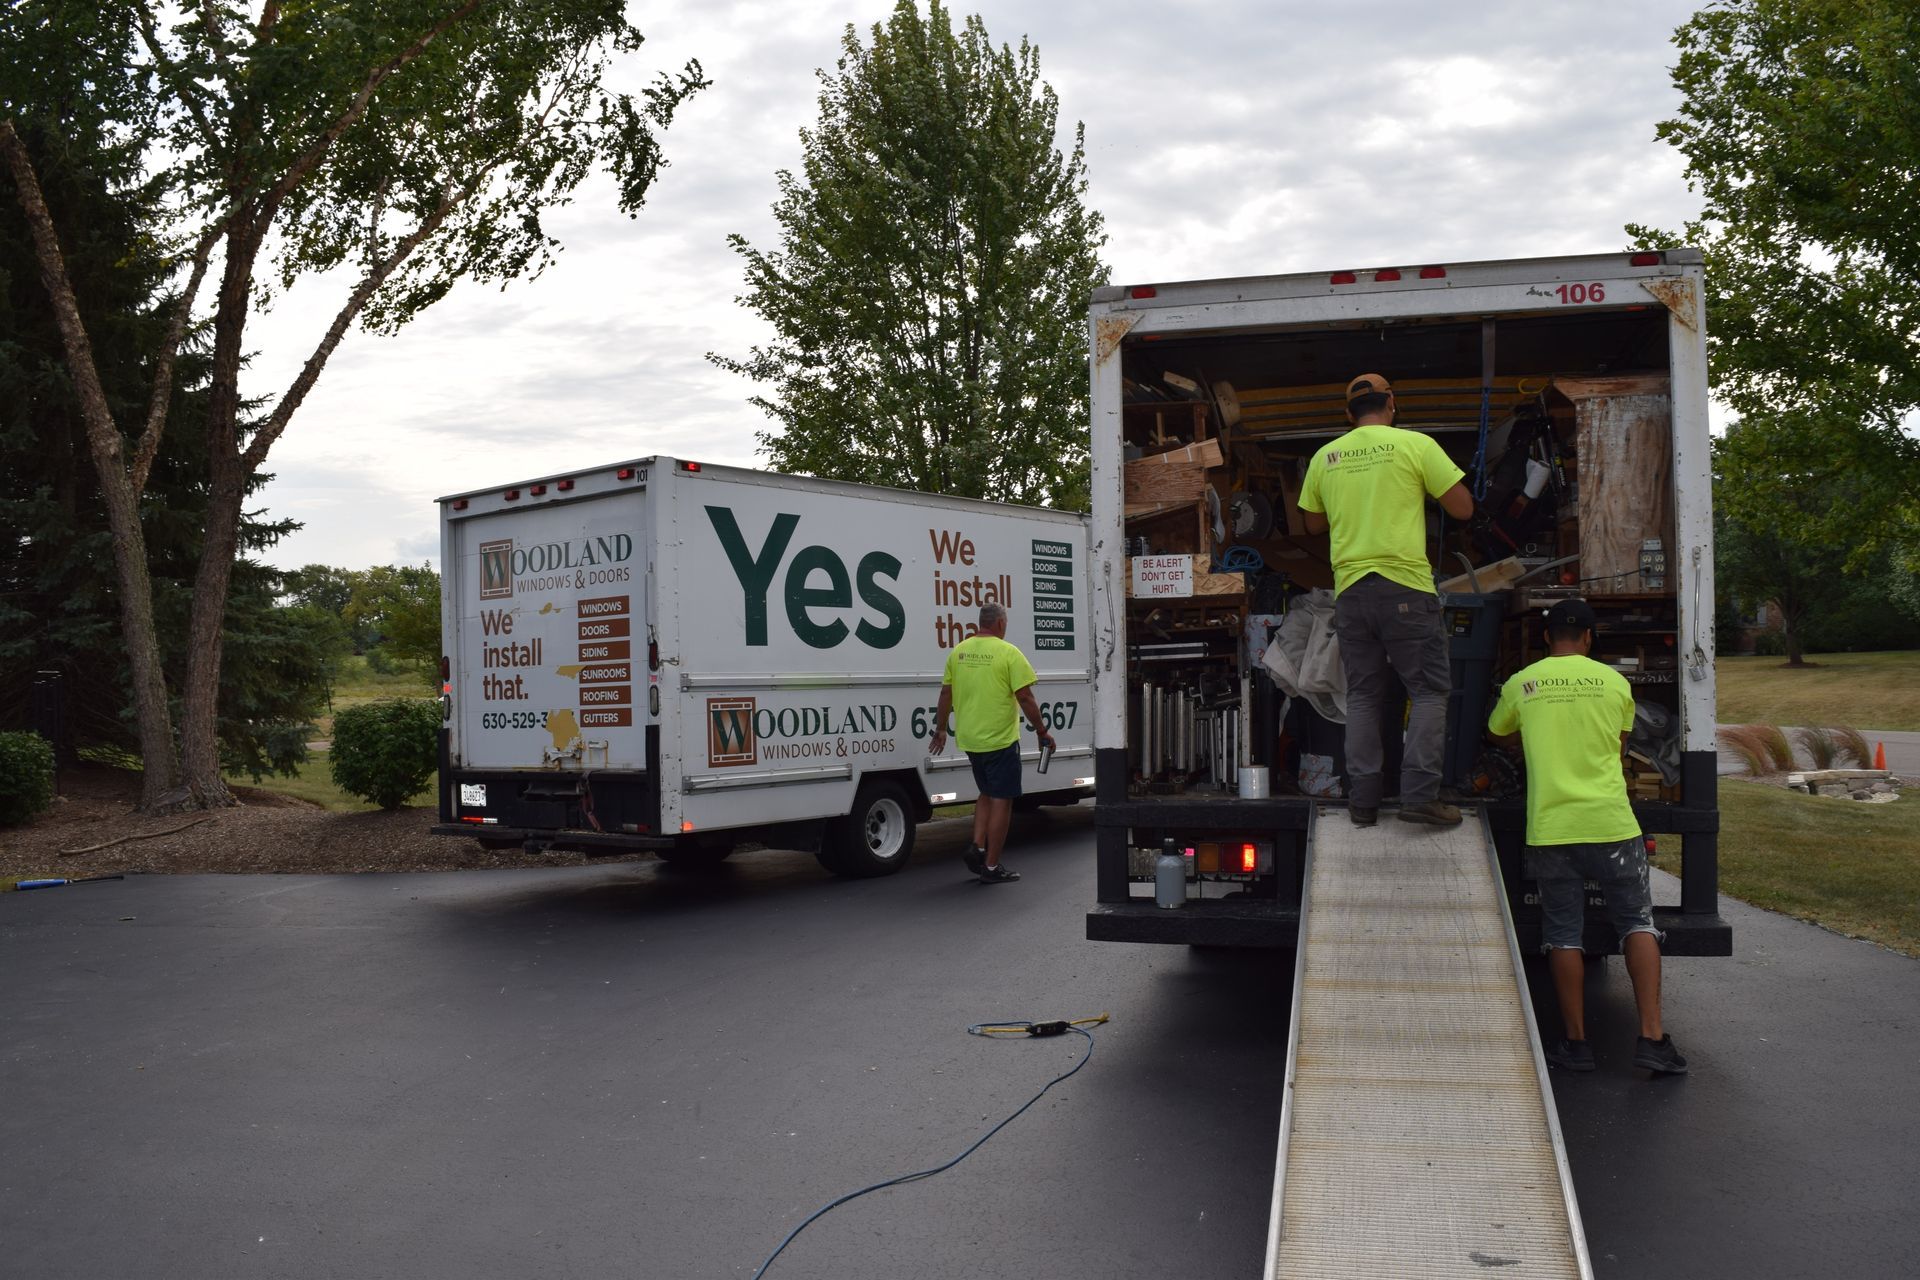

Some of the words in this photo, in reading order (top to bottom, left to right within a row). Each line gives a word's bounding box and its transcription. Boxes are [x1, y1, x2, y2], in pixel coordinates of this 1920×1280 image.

[1555, 282, 1605, 304] 106
[1327, 444, 1394, 464] WOODLAND
[636, 469, 648, 482] 101
[929, 529, 976, 566] We
[1034, 543, 1067, 555] WINDOWS
[482, 533, 633, 588] WOODLAND
[1142, 559, 1154, 568] BE
[1156, 558, 1183, 568] ALERT
[1034, 562, 1058, 573] DOORS
[517, 575, 571, 592] WINDOWS
[575, 569, 586, 589] &
[589, 567, 630, 585] DOORS
[704, 505, 906, 649] Yes
[1141, 571, 1167, 581] DON'T
[1168, 571, 1185, 580] GET
[934, 570, 1012, 608] install
[1035, 581, 1057, 591] SIDING
[1152, 584, 1175, 594] HURT
[581, 601, 622, 614] WINDOWS
[1035, 600, 1068, 610] SUNROOM
[480, 609, 513, 636] We
[1036, 619, 1066, 629] ROOFING
[581, 624, 610, 635] DOORS
[935, 613, 978, 648] tha
[1037, 637, 1066, 647] GUTTERS
[483, 638, 542, 668] install
[581, 647, 608, 658] SIDING
[582, 667, 627, 680] SUNROOMS
[483, 673, 529, 700] that.
[1523, 678, 1604, 695] WOODLAND
[582, 690, 619, 702] ROOFING
[583, 712, 619, 724] GUTTERS
[710, 705, 897, 754] WOODLAND
[763, 742, 831, 760] WINDOWS
[836, 737, 848, 757] &
[852, 739, 895, 755] DOORS
